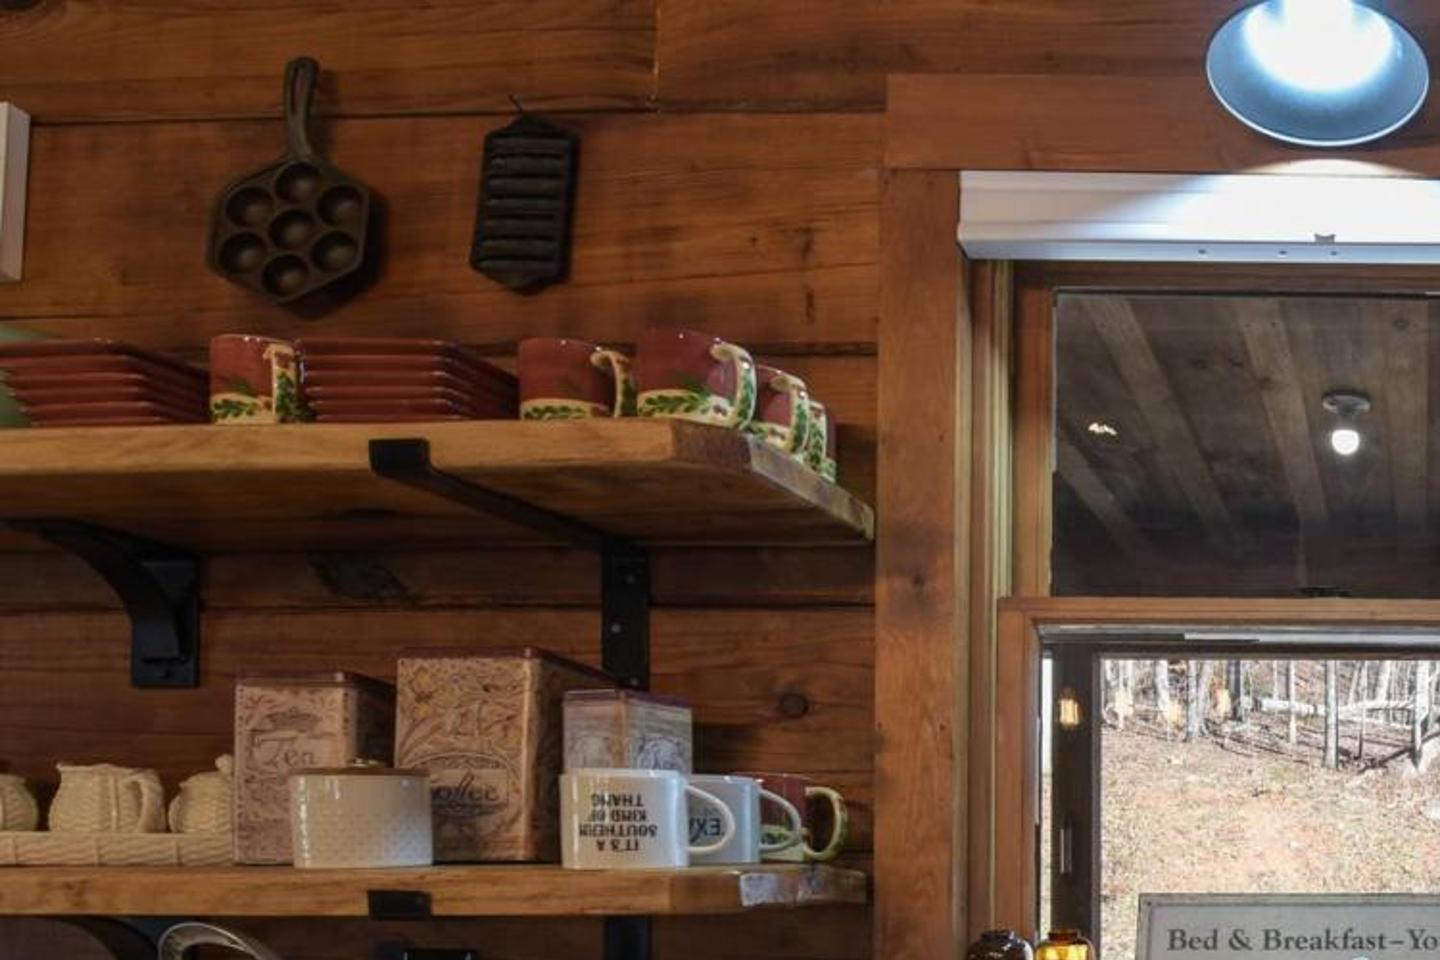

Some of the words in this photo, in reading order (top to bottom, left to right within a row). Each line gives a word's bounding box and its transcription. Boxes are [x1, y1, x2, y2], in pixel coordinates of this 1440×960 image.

[431, 768, 500, 806] offee
[609, 809, 647, 823] KIND
[595, 839, 606, 853] A
[1167, 928, 1218, 952] Bed
[1228, 928, 1253, 952] &
